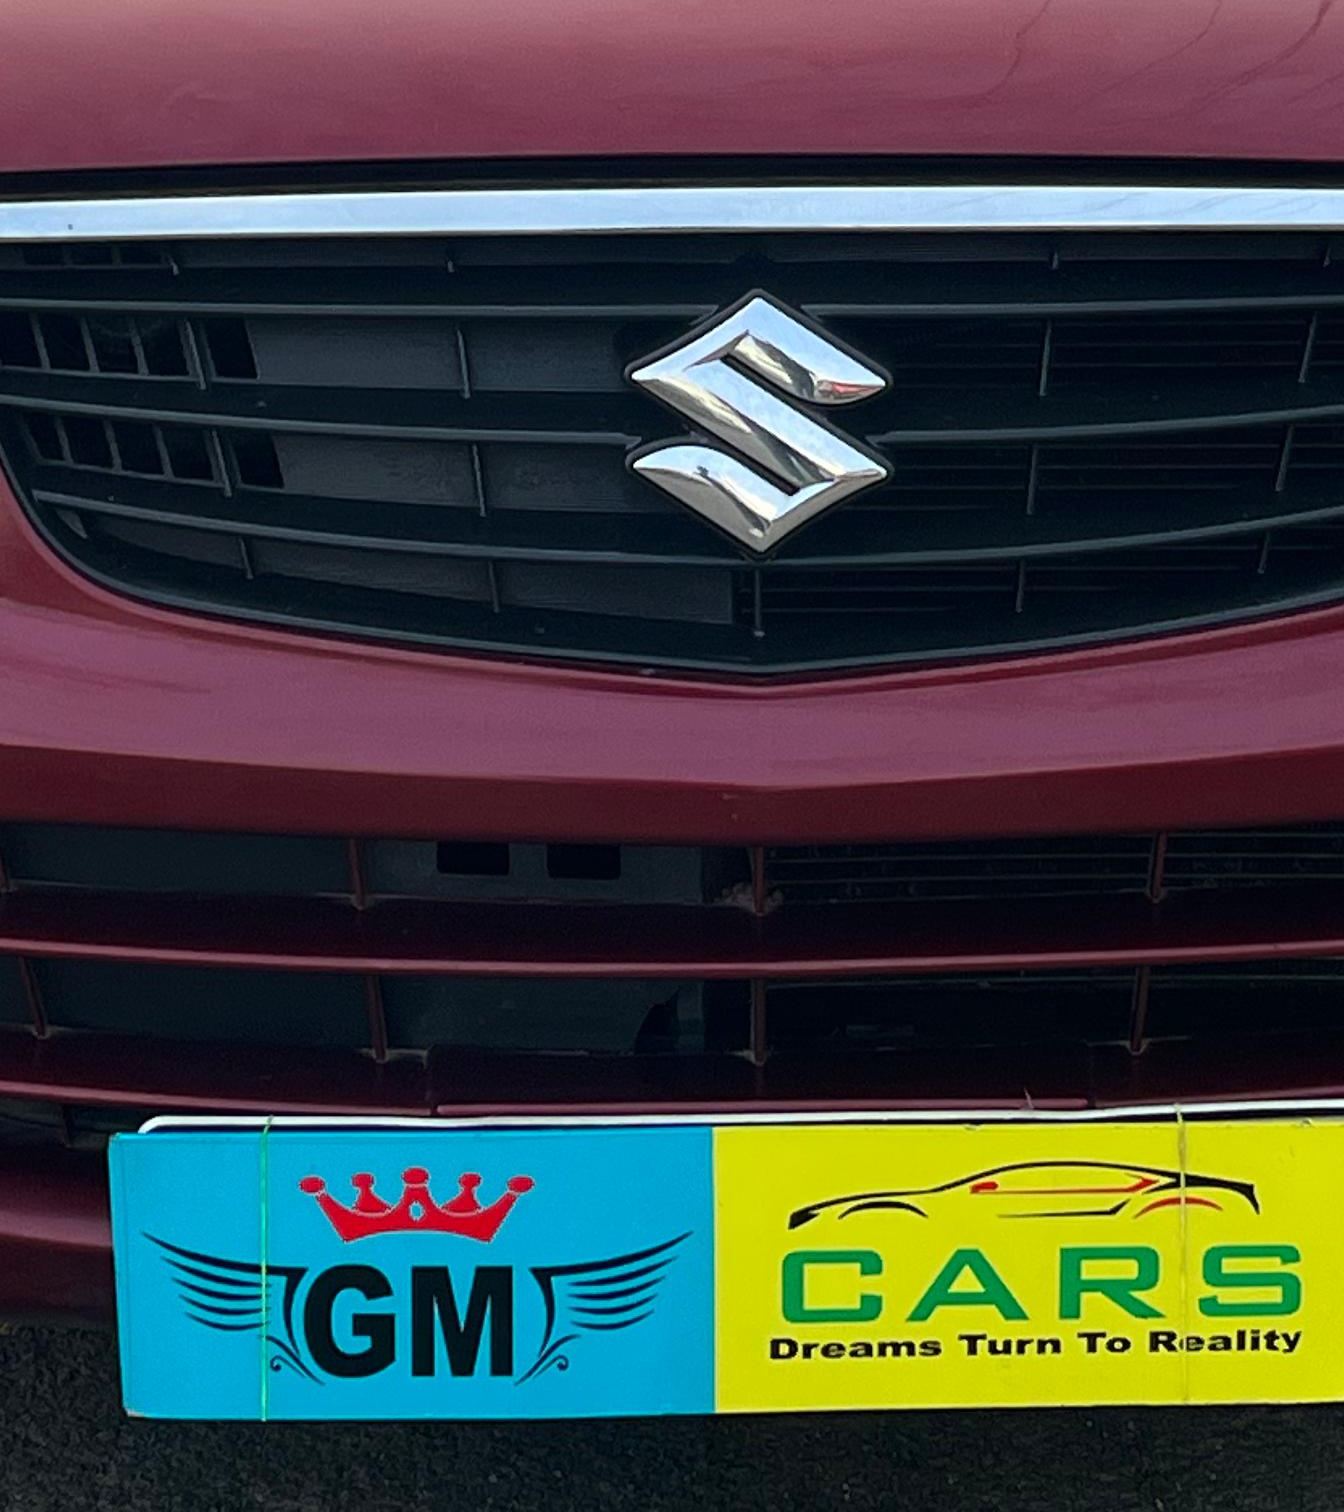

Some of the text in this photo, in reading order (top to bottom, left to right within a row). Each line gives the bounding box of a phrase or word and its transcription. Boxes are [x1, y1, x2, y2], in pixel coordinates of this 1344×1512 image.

[303, 1263, 514, 1378] GM
[781, 1244, 1302, 1323] CARS
[769, 1329, 1303, 1361] Dreams Turn To Reality
